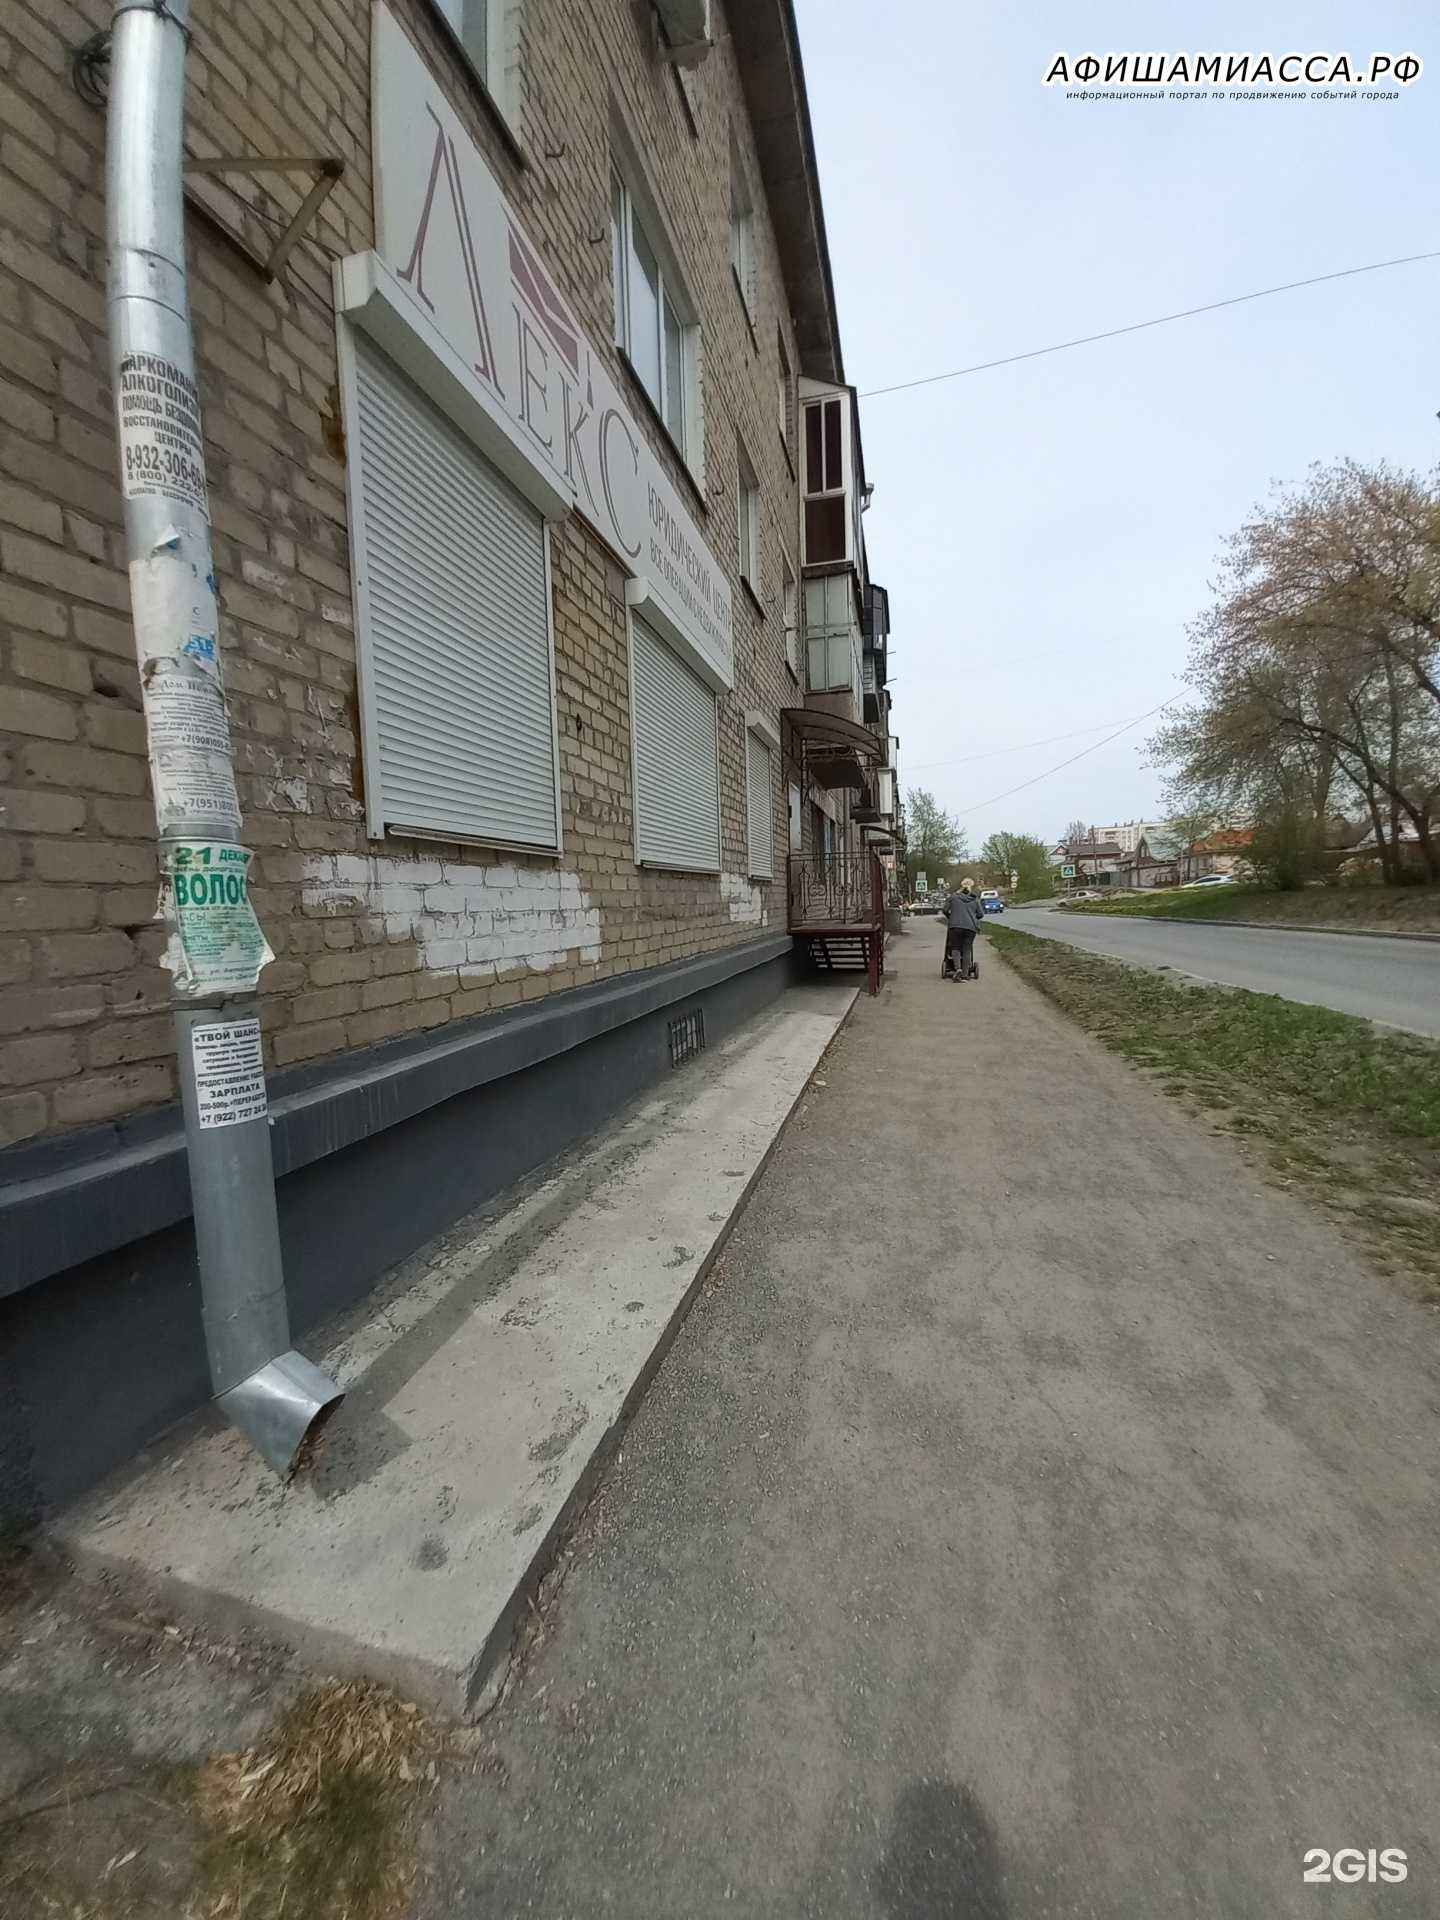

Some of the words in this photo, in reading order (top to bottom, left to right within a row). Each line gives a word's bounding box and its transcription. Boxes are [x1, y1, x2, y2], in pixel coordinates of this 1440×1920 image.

[397, 101, 642, 559] ЛЕКС
[648, 481, 711, 605] ЮРИДИЧЕСКИЙ
[176, 846, 212, 865] 21
[210, 1082, 260, 1098] ЗАРПЛАТА
